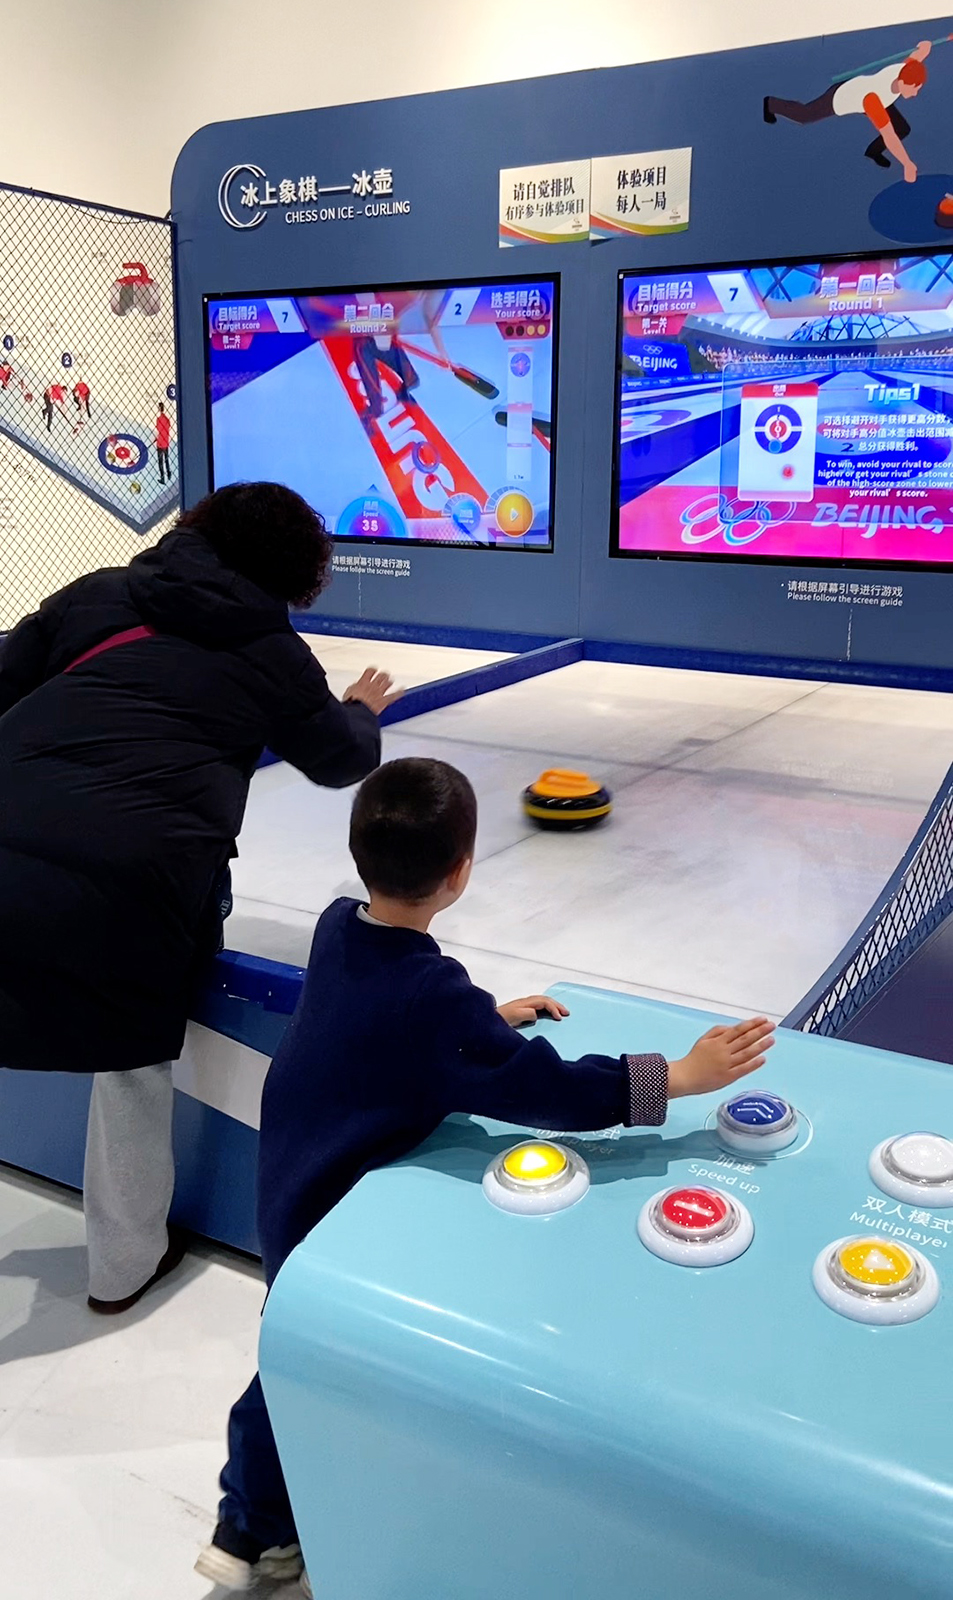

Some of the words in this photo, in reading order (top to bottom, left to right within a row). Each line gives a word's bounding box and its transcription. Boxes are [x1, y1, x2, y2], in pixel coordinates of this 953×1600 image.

[617, 166, 667, 190] 体验项目
[513, 177, 576, 201] 请自觉排队
[505, 198, 585, 221] 有序参与体验项目
[616, 191, 667, 214] 每人一局
[285, 209, 318, 224] CHESS
[320, 208, 336, 221] ON
[338, 206, 355, 219] ICE
[365, 200, 411, 217] CURLING
[637, 280, 693, 302] 目标得分
[819, 272, 896, 299] 第一回合
[490, 289, 541, 309] 选手得分
[728, 288, 739, 301] 7
[343, 303, 395, 322] 第二回合
[454, 303, 463, 316] 2
[637, 302, 669, 314] Target
[670, 301, 697, 311] score
[828, 298, 872, 312] Round
[875, 297, 884, 309] 1
[218, 305, 258, 321] 目标得分
[281, 312, 289, 324] 7
[494, 309, 516, 318] Your
[516, 308, 541, 317] score
[218, 322, 241, 331] Target
[242, 321, 261, 330] score
[350, 322, 380, 333] Round
[380, 322, 387, 332] 2
[642, 317, 668, 329] 第一关
[628, 354, 678, 372] BEIJING
[863, 383, 920, 405] Tips1
[841, 443, 854, 452] 2
[826, 460, 837, 468] To
[857, 460, 880, 468] avoid
[880, 462, 900, 471] your
[901, 459, 922, 468] rival
[818, 469, 844, 479] higher
[855, 471, 869, 479] get
[870, 471, 890, 480] your
[923, 470, 948, 478] stone
[852, 479, 894, 488] high-score
[917, 479, 927, 487] to
[849, 489, 869, 498] your
[902, 489, 928, 498] score.
[810, 503, 945, 539] BEIJING
[349, 565, 365, 574] follow
[376, 568, 394, 576] screen
[395, 570, 411, 578] guide
[787, 580, 903, 598] 请根据屏幕引导进行游戏
[787, 592, 812, 601] Please
[813, 593, 837, 603] follow
[838, 595, 852, 603] the
[852, 597, 879, 605] screen
[879, 598, 903, 608] guide
[713, 1153, 756, 1175] 加速
[688, 1163, 739, 1186] Speed
[739, 1181, 761, 1195] up
[861, 1195, 953, 1234] 双人模式
